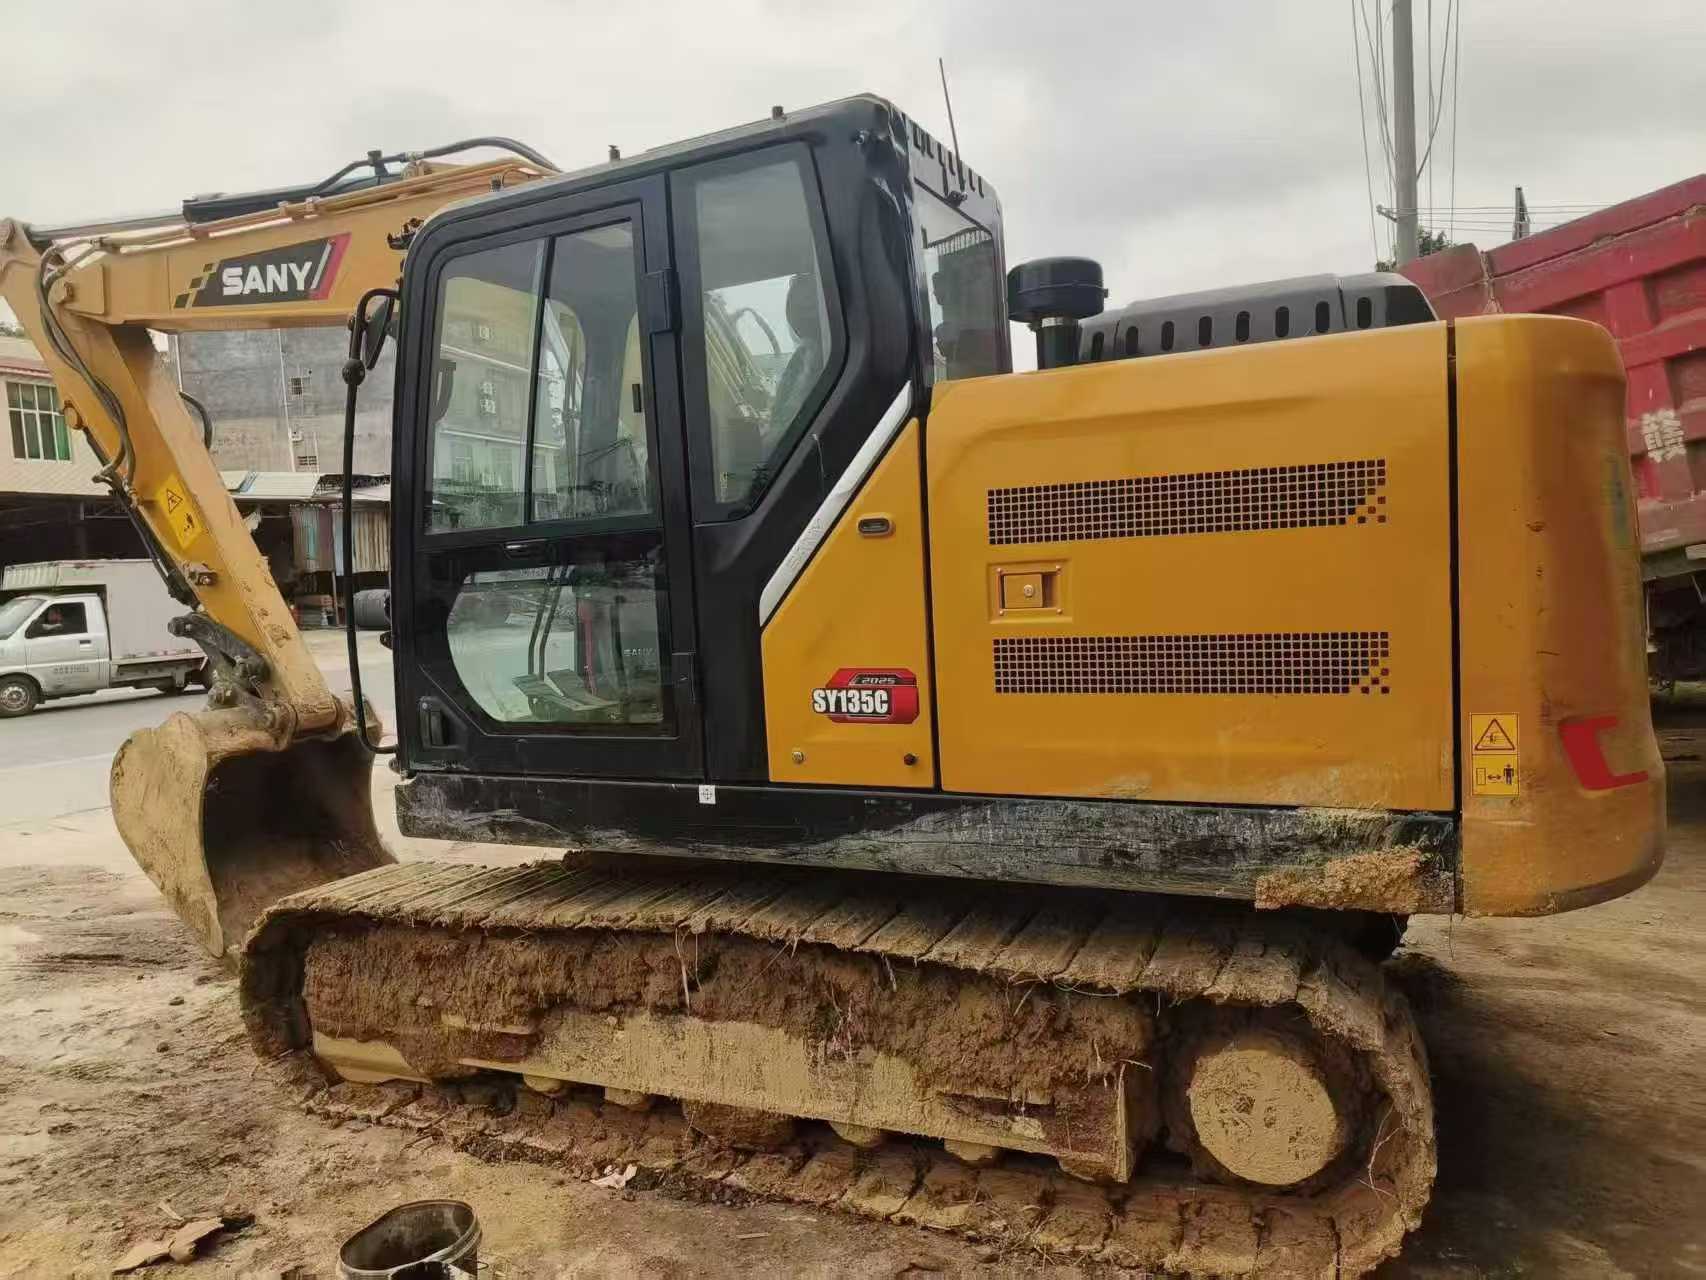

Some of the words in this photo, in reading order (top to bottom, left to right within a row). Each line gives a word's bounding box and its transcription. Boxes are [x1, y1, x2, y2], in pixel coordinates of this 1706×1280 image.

[222, 261, 313, 296] SANY
[861, 677, 896, 685] 2025
[812, 689, 889, 714] SY135C
